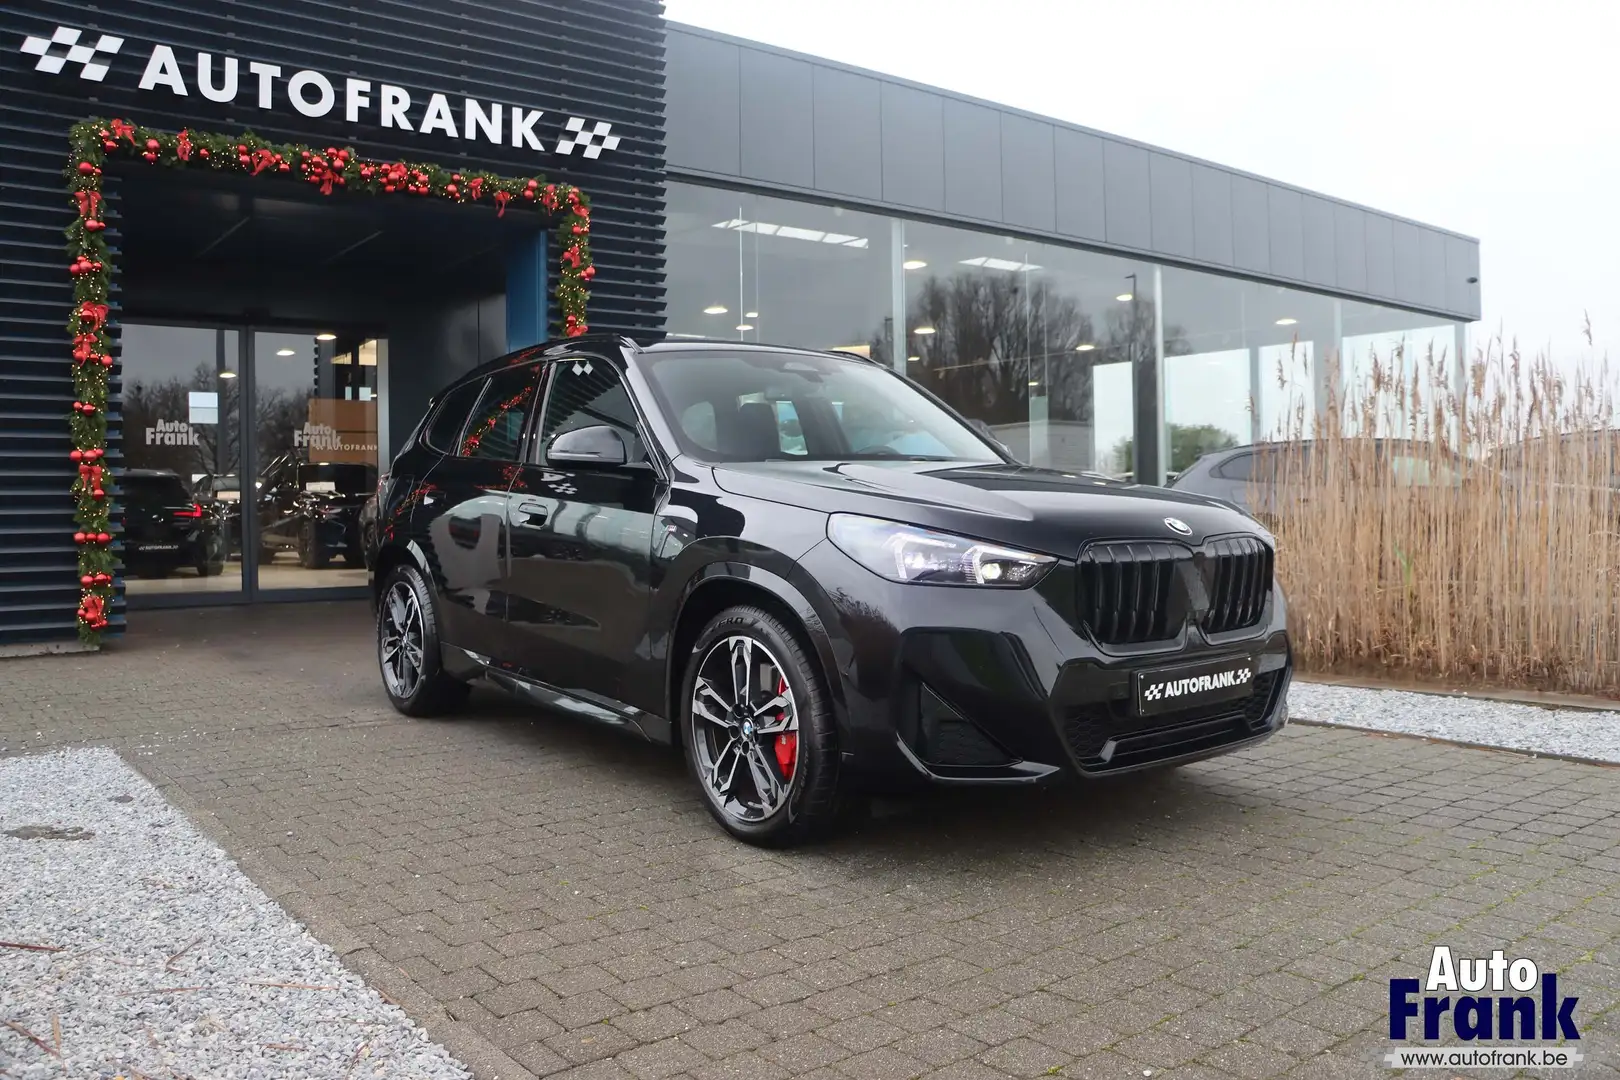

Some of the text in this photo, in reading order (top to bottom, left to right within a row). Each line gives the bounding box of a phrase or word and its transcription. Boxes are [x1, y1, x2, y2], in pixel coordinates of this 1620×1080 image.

[138, 44, 545, 152] AUTOFRANK
[156, 418, 189, 433] Auto
[303, 422, 332, 435] Auto
[145, 427, 200, 446] Frank
[294, 429, 341, 447] Frank
[1164, 671, 1236, 698] AUTOFRANK
